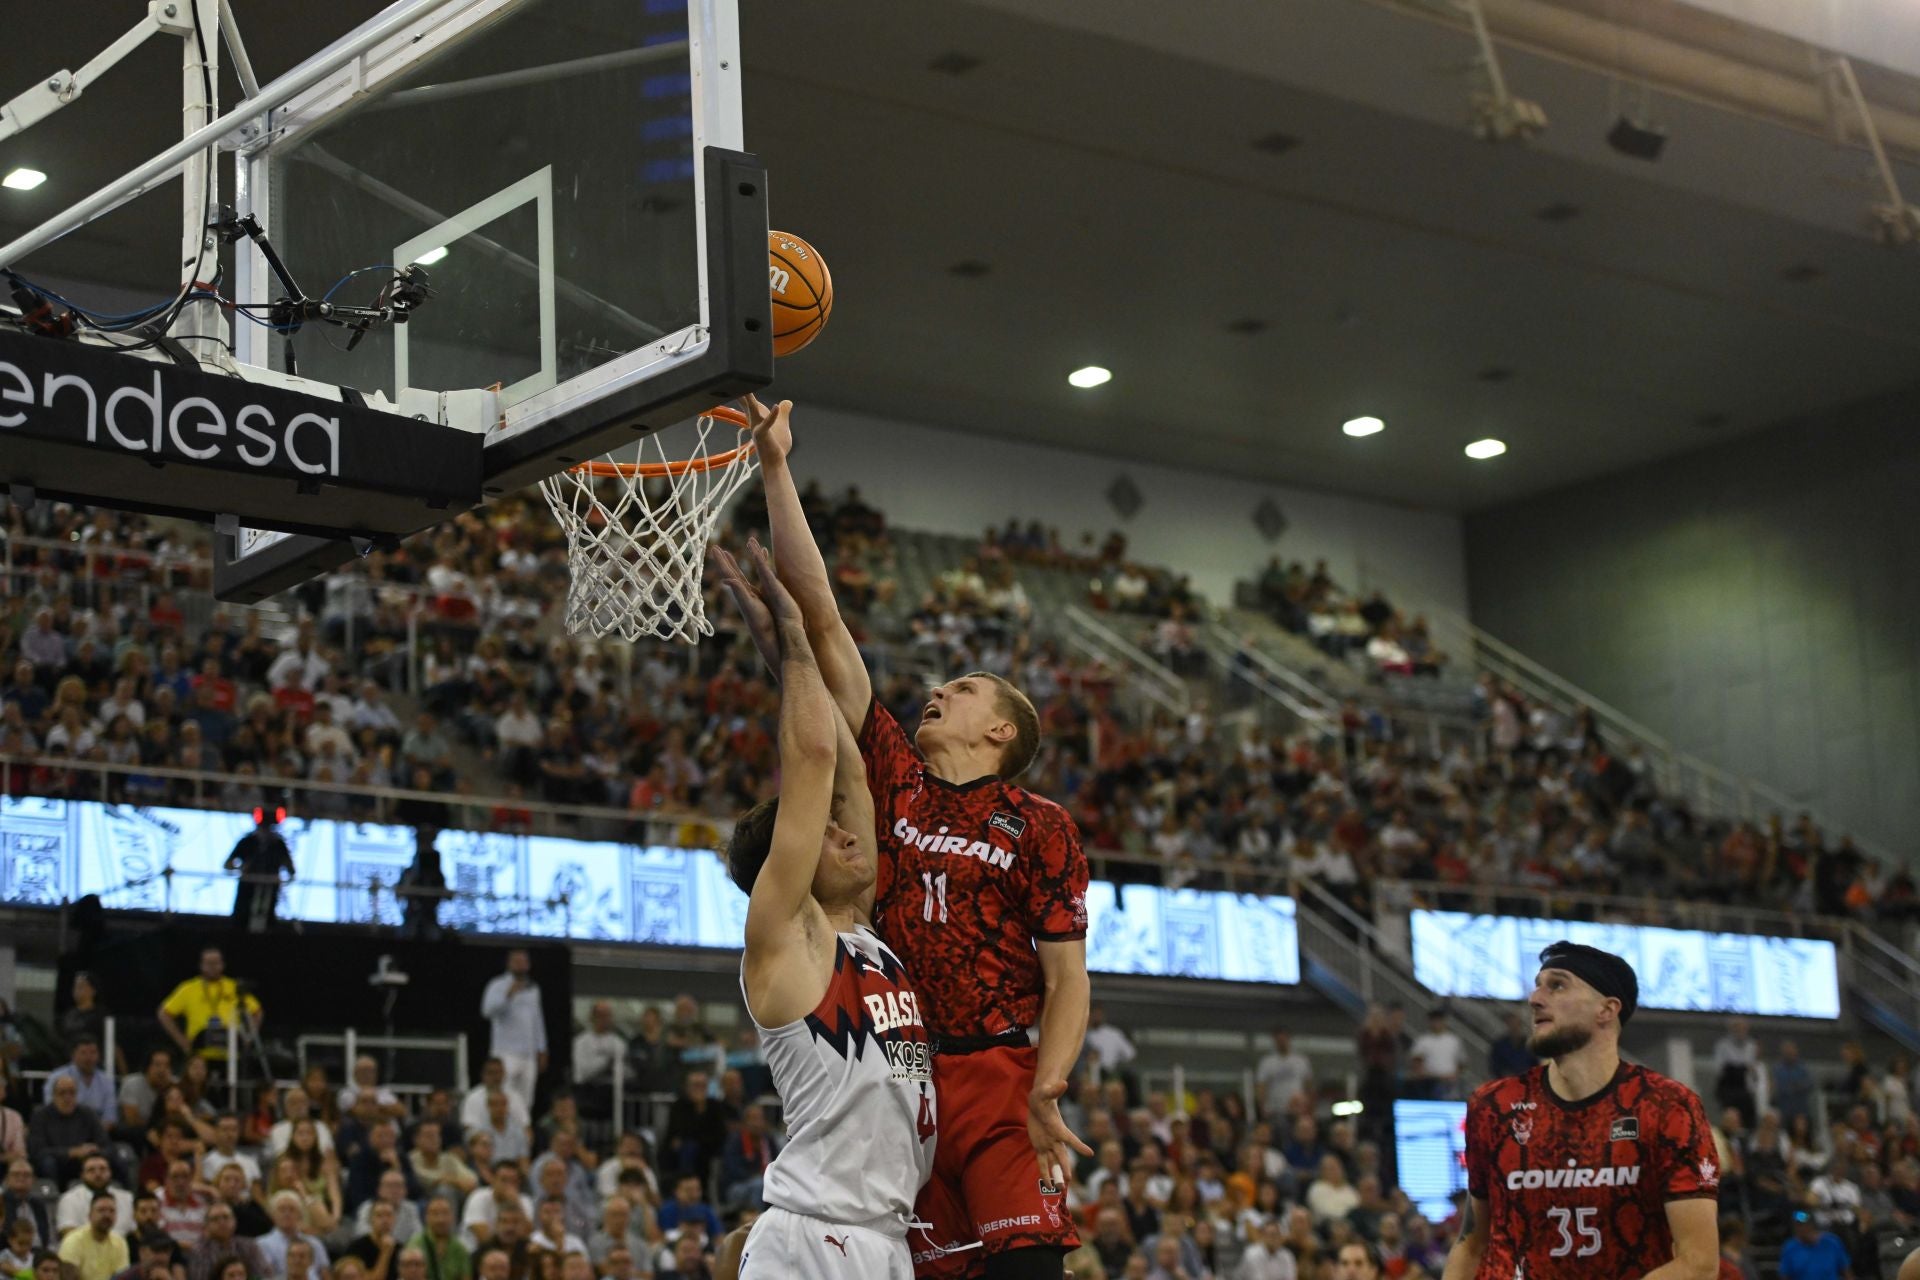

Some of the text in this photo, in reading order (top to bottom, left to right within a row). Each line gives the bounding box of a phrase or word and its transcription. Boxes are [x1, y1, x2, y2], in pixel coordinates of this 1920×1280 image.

[0, 361, 340, 477] endesa
[922, 871, 948, 924] 11
[983, 1215, 1041, 1233] BERNER
[1546, 1205, 1602, 1257] 35
